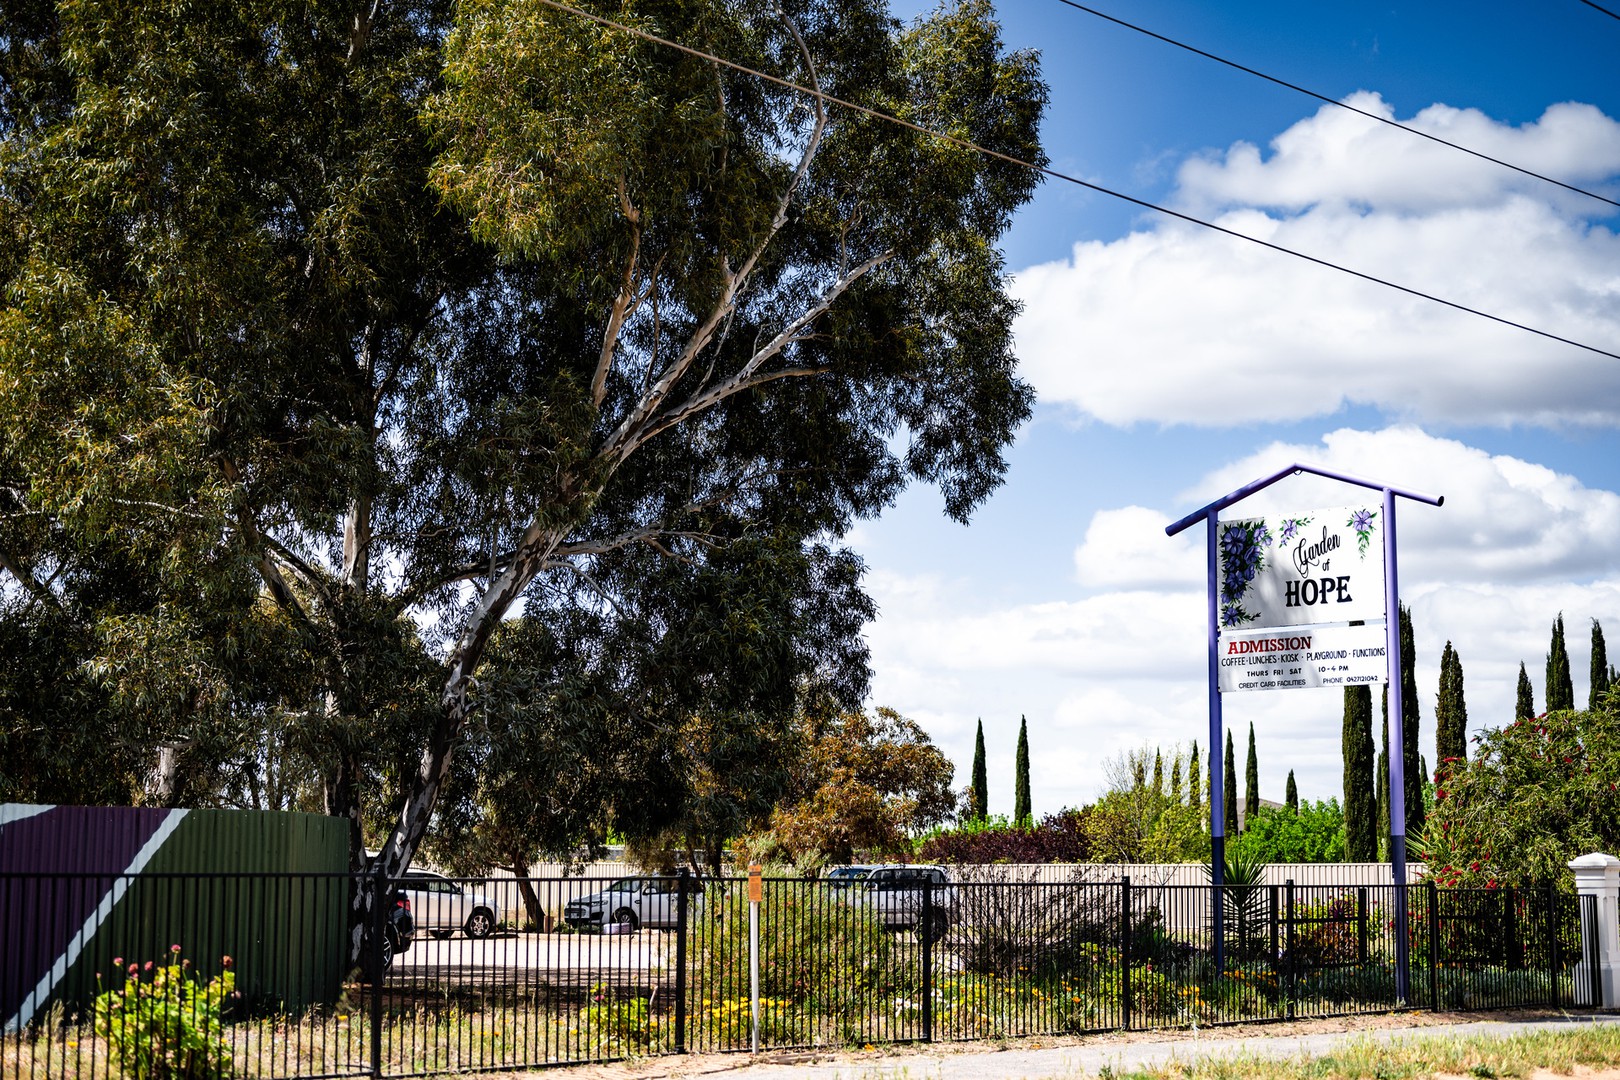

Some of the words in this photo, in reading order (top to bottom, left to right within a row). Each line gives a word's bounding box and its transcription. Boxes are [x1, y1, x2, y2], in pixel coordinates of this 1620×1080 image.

[1293, 526, 1340, 578] Garden
[1322, 559, 1330, 571] of
[1285, 576, 1352, 607] HOPE
[1228, 636, 1312, 654] ADMISSION
[1281, 654, 1299, 663] KIOSK
[1307, 650, 1347, 661] PLAYGROUND
[1353, 647, 1385, 657] FUNCTIONS
[1238, 681, 1258, 689] CREDIT
